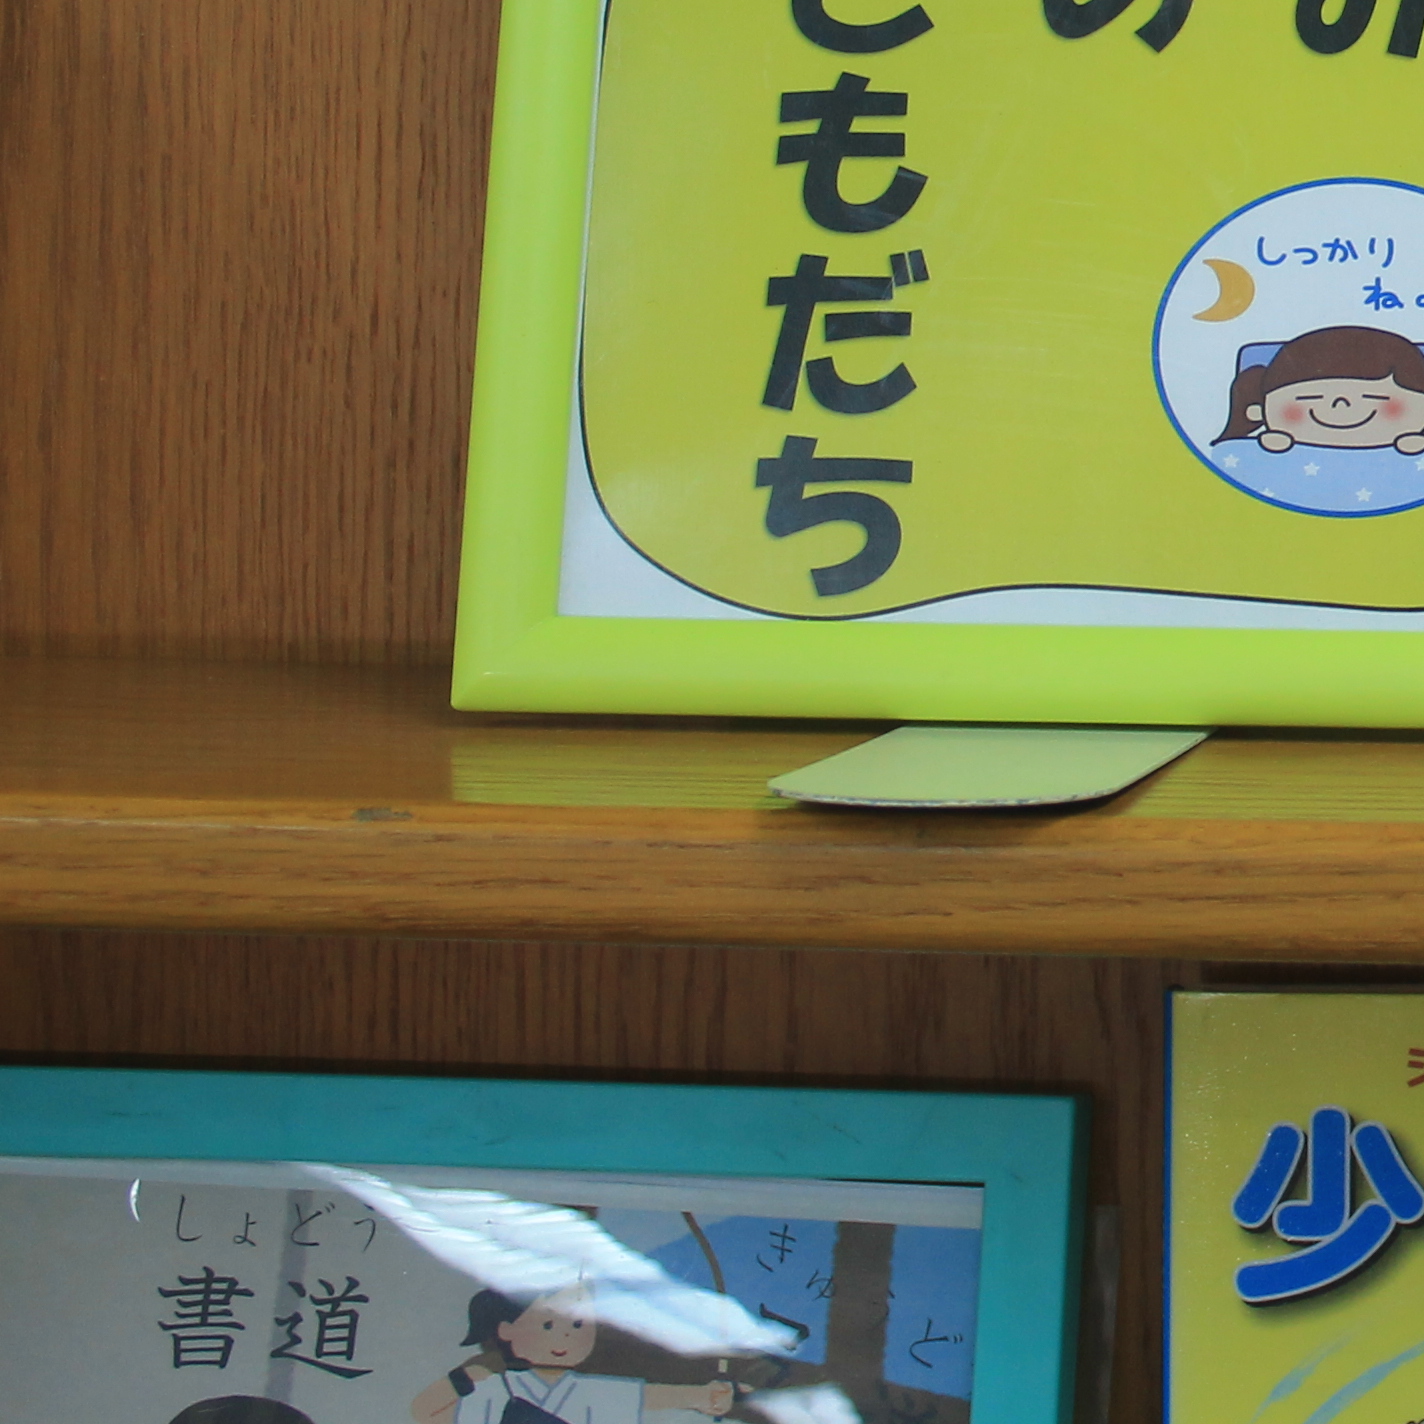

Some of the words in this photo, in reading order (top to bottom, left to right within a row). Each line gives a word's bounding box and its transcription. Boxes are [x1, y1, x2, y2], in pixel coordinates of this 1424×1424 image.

[1256, 235, 1396, 268] しっかり
[176, 1194, 377, 1253] しょどう
[156, 1265, 374, 1379] 書道
